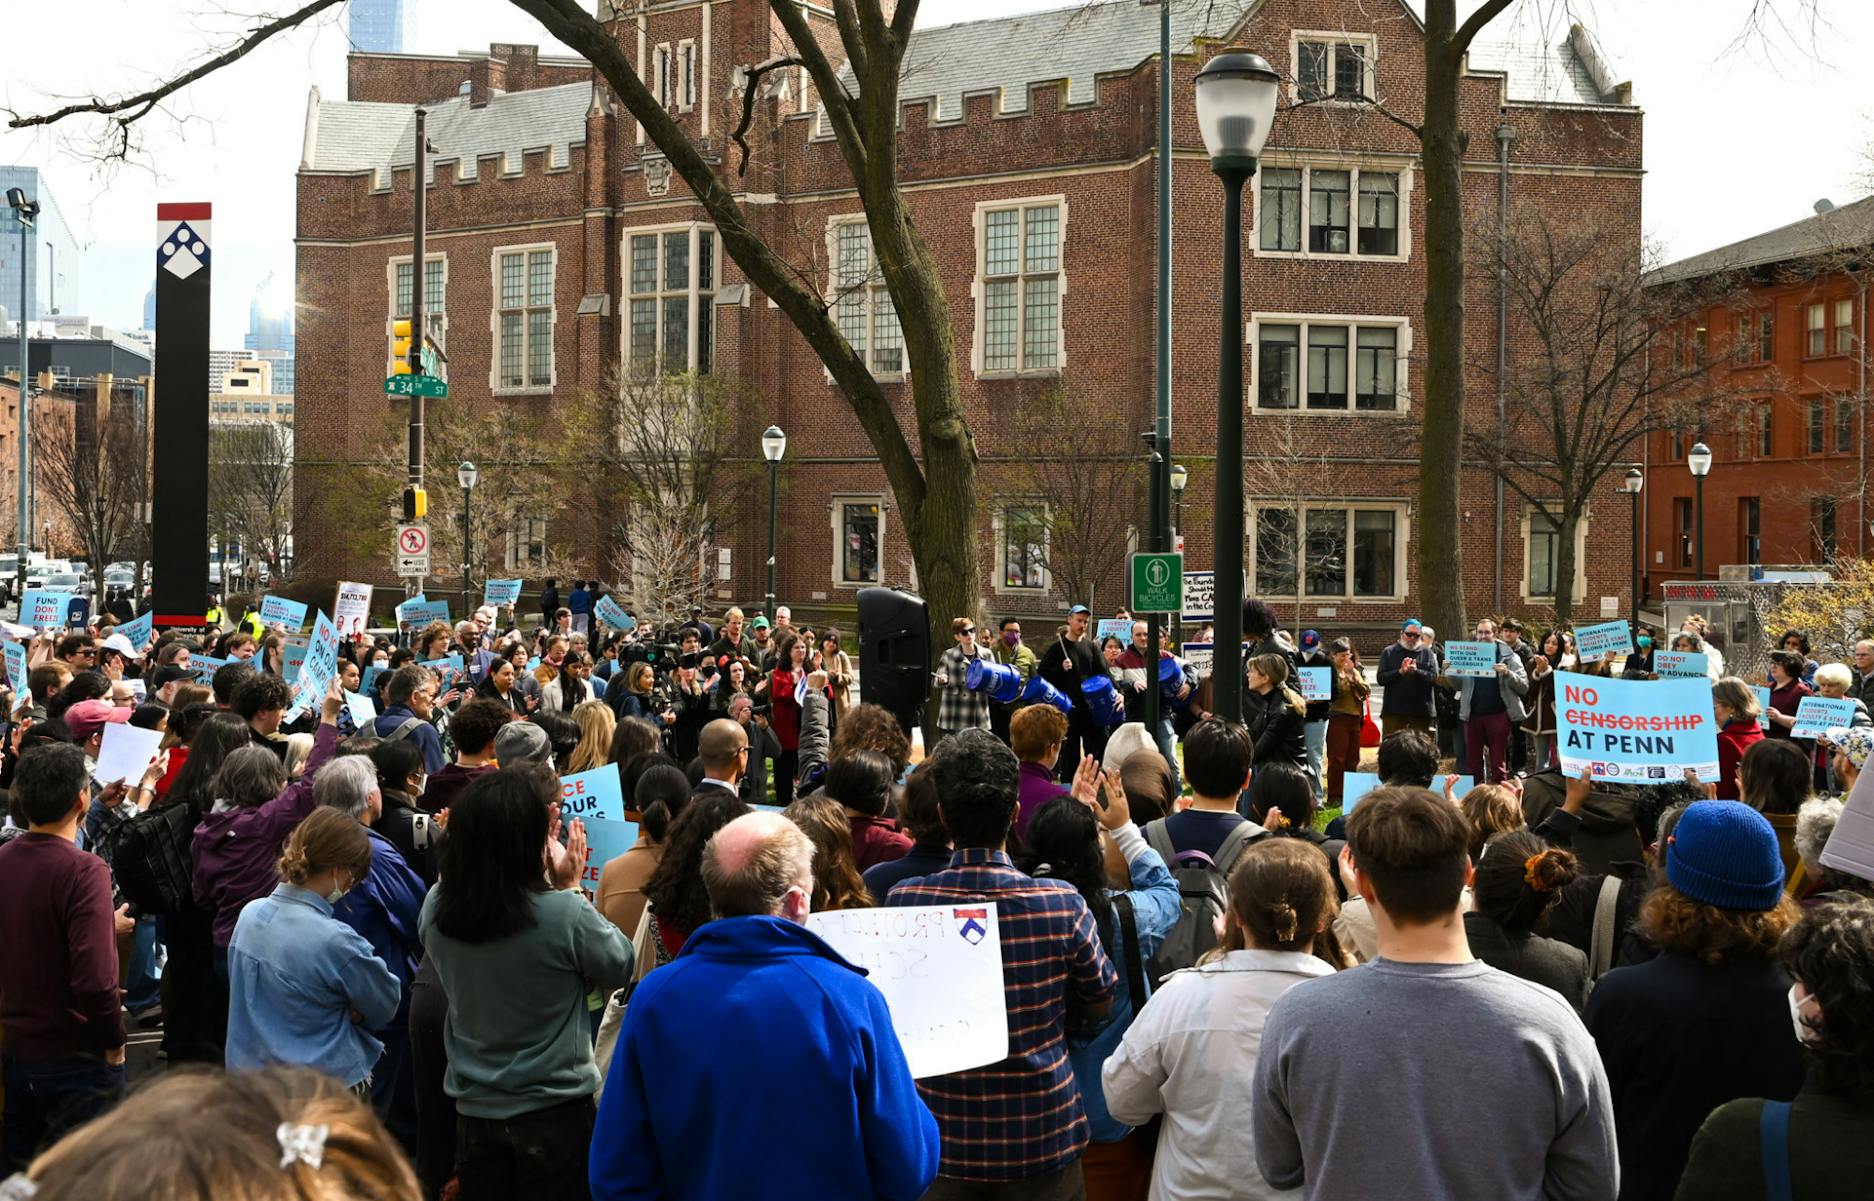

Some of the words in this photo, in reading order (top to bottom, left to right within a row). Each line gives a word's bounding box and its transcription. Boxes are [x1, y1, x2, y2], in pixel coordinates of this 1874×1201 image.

[435, 386, 444, 394] ST
[36, 597, 58, 605] FUND
[319, 623, 330, 641] NO
[1578, 626, 1621, 637] INTERNATIONAL
[315, 640, 326, 659] ON
[192, 660, 204, 668] DO
[1565, 684, 1599, 706] NO
[1803, 702, 1846, 711] INTERNATIONAL
[1565, 708, 1704, 731] CENSORSHIP
[1567, 729, 1595, 750] AT
[1604, 733, 1675, 754] PENN
